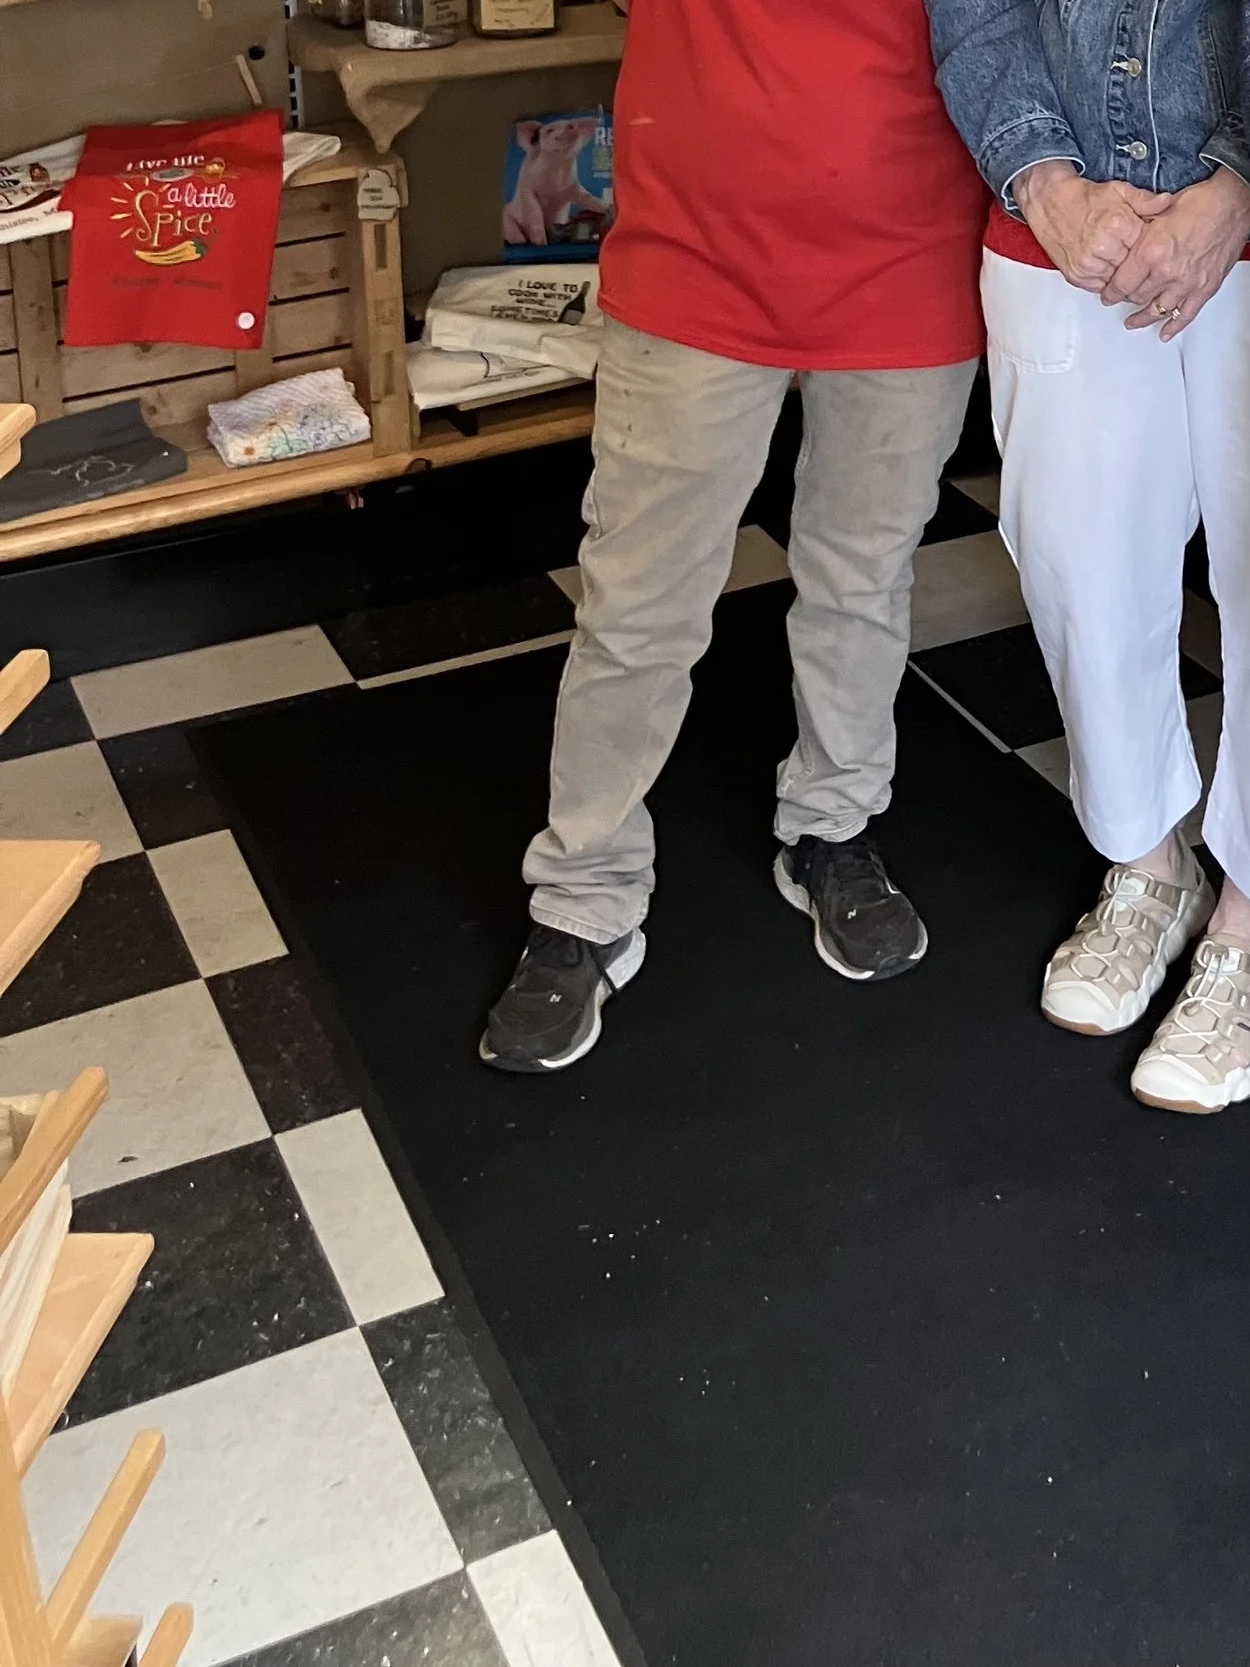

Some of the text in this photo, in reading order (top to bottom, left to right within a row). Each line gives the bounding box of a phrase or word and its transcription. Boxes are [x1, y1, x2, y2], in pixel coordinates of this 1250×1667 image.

[167, 182, 237, 208] a little
[526, 281, 557, 291] LOVE
[563, 283, 578, 292] TO
